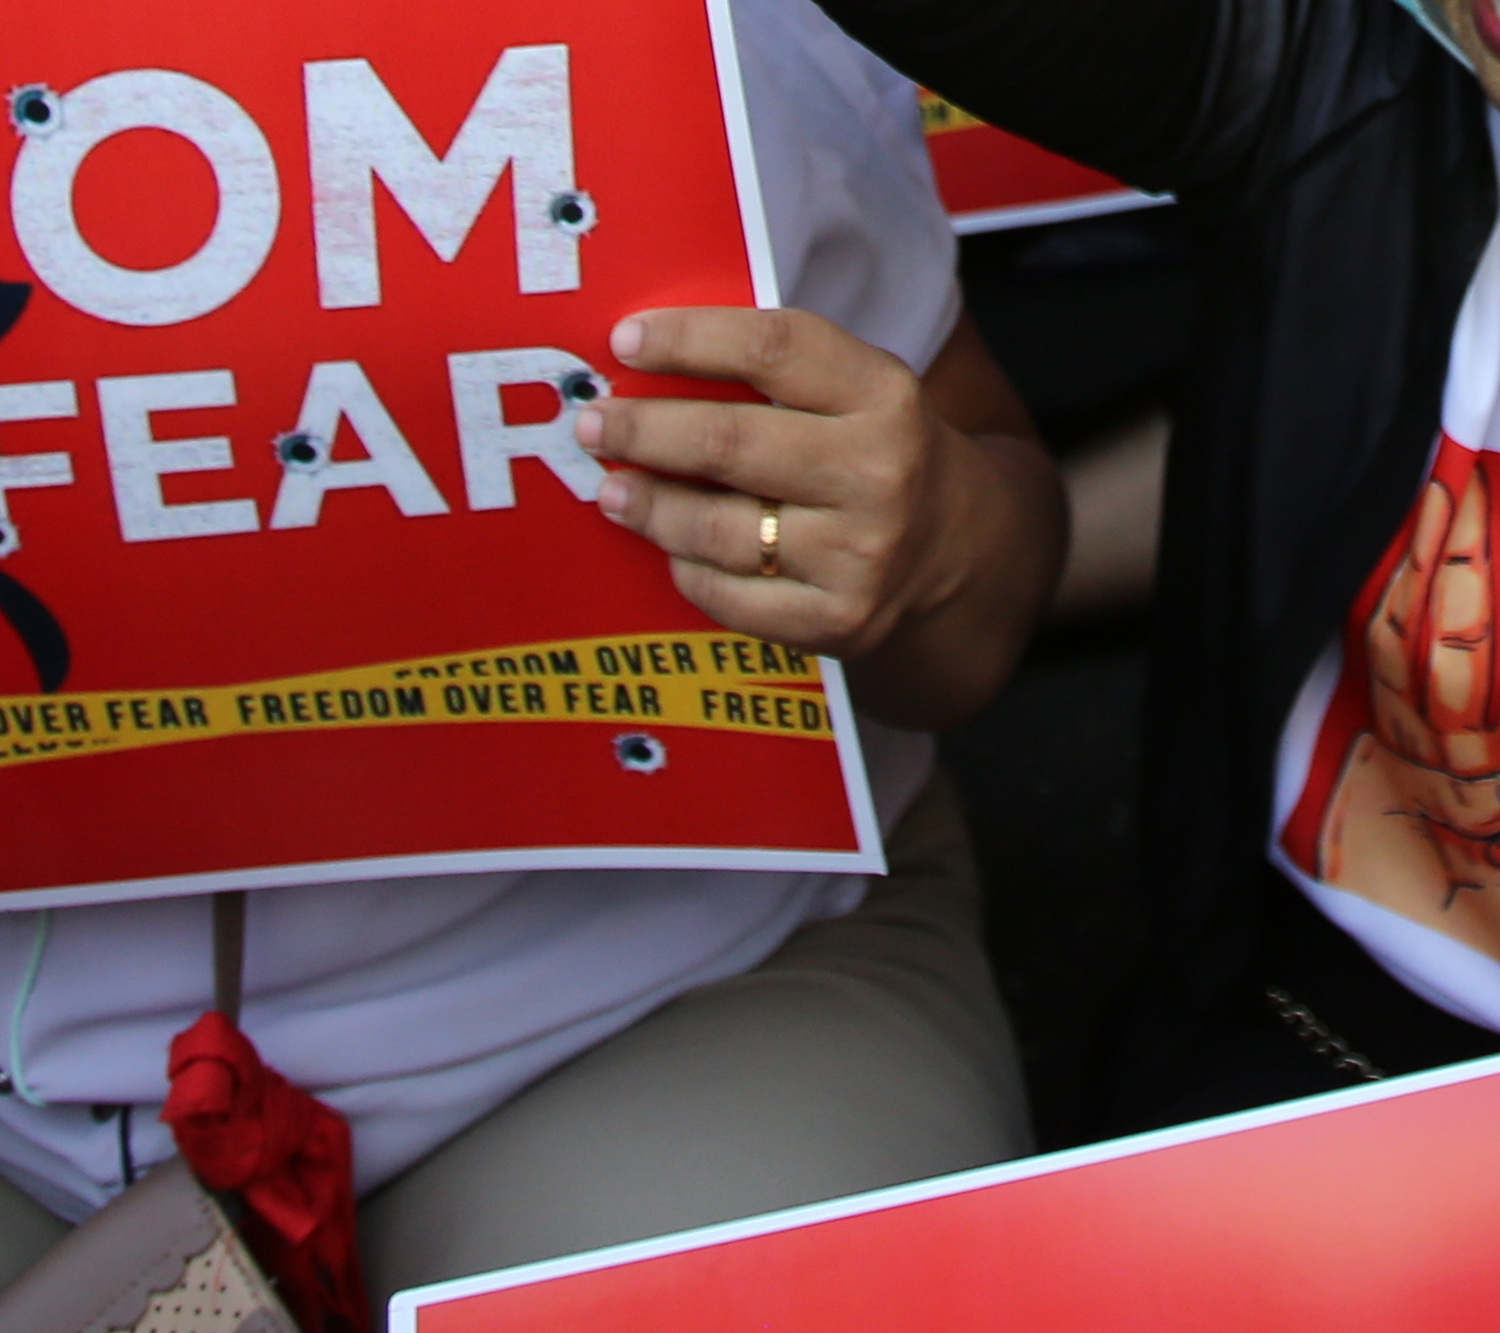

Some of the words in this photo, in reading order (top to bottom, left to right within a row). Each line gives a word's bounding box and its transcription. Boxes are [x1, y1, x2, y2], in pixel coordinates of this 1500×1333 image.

[599, 641, 697, 677] OVER
[708, 639, 809, 677] FEAR
[103, 696, 211, 732] FEAR
[235, 684, 427, 726] FREEDOM
[442, 683, 548, 717] OVER
[562, 682, 663, 718] FEAR
